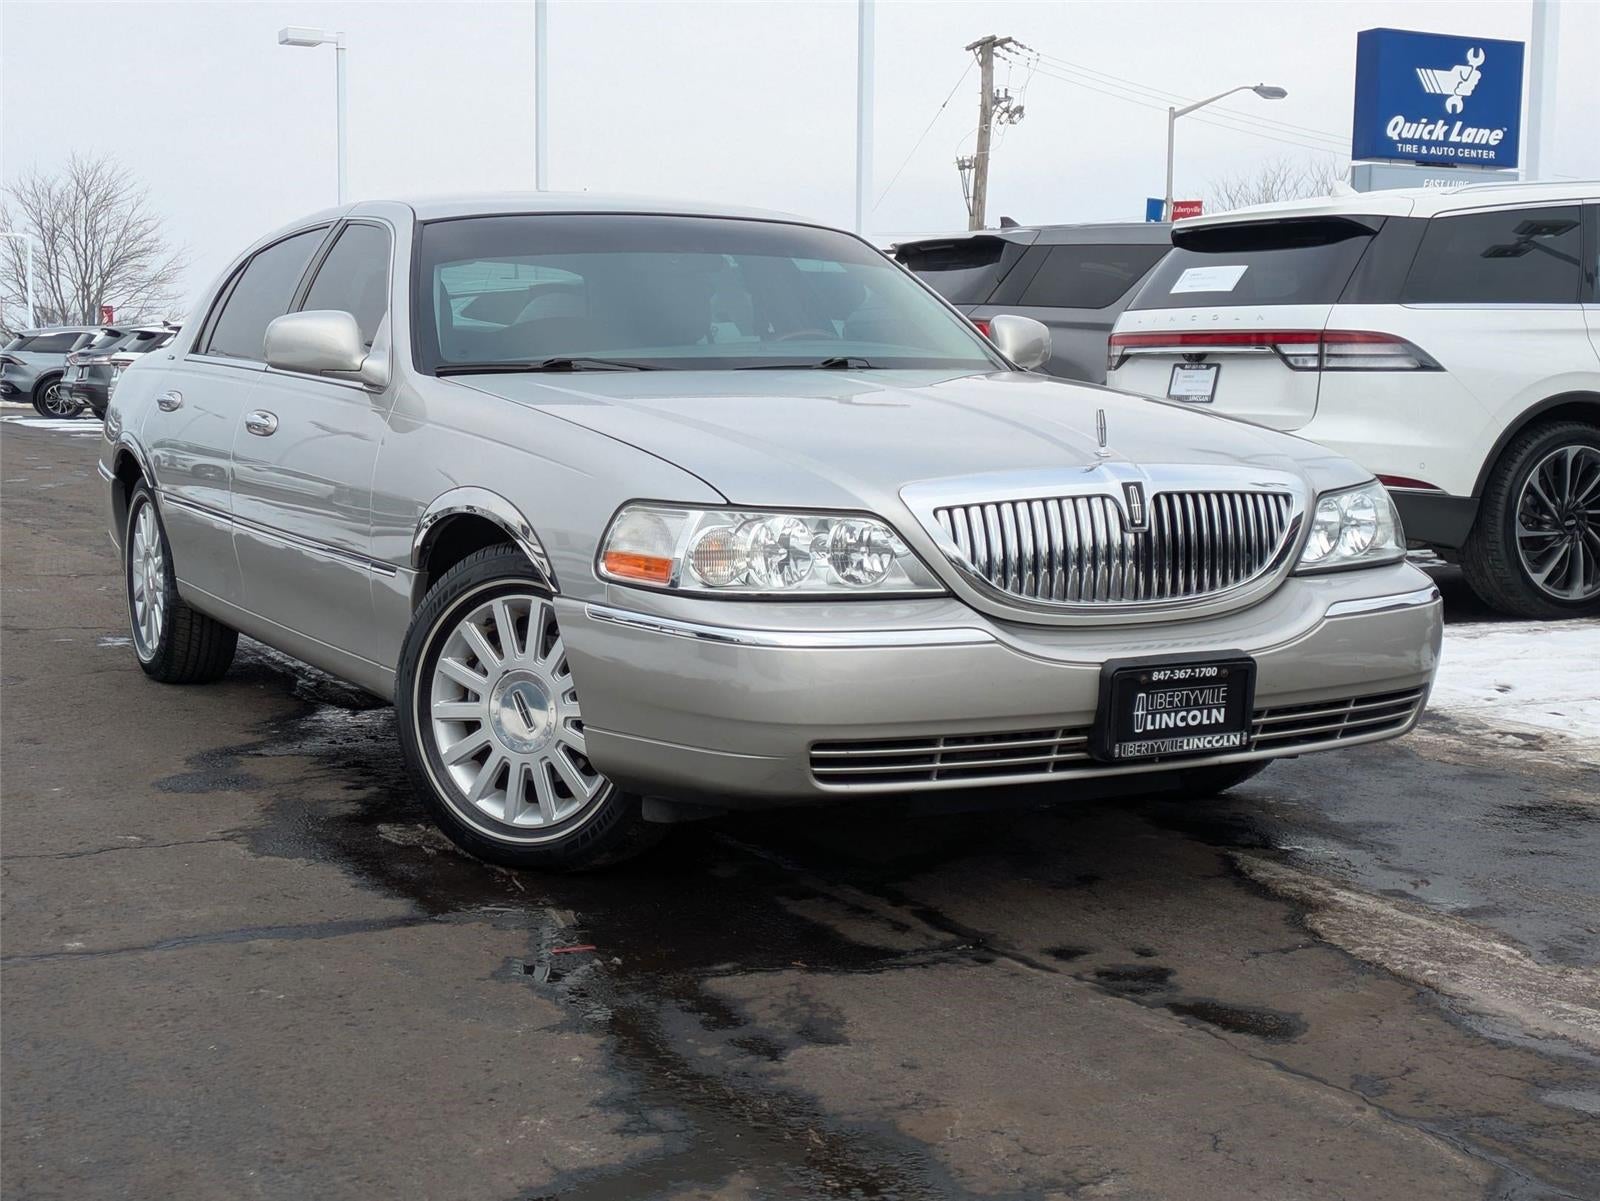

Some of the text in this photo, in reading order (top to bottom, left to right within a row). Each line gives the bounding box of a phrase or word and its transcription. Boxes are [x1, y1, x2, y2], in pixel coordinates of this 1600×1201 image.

[1386, 115, 1504, 146] Quick Lane
[1396, 143, 1496, 159] TIRE & AUTO CENTER
[1423, 178, 1445, 188] FAST
[1152, 667, 1218, 681] 847-367-1700
[1148, 687, 1228, 710] LIBERTYVILLE
[1146, 708, 1226, 730] LINCOLN
